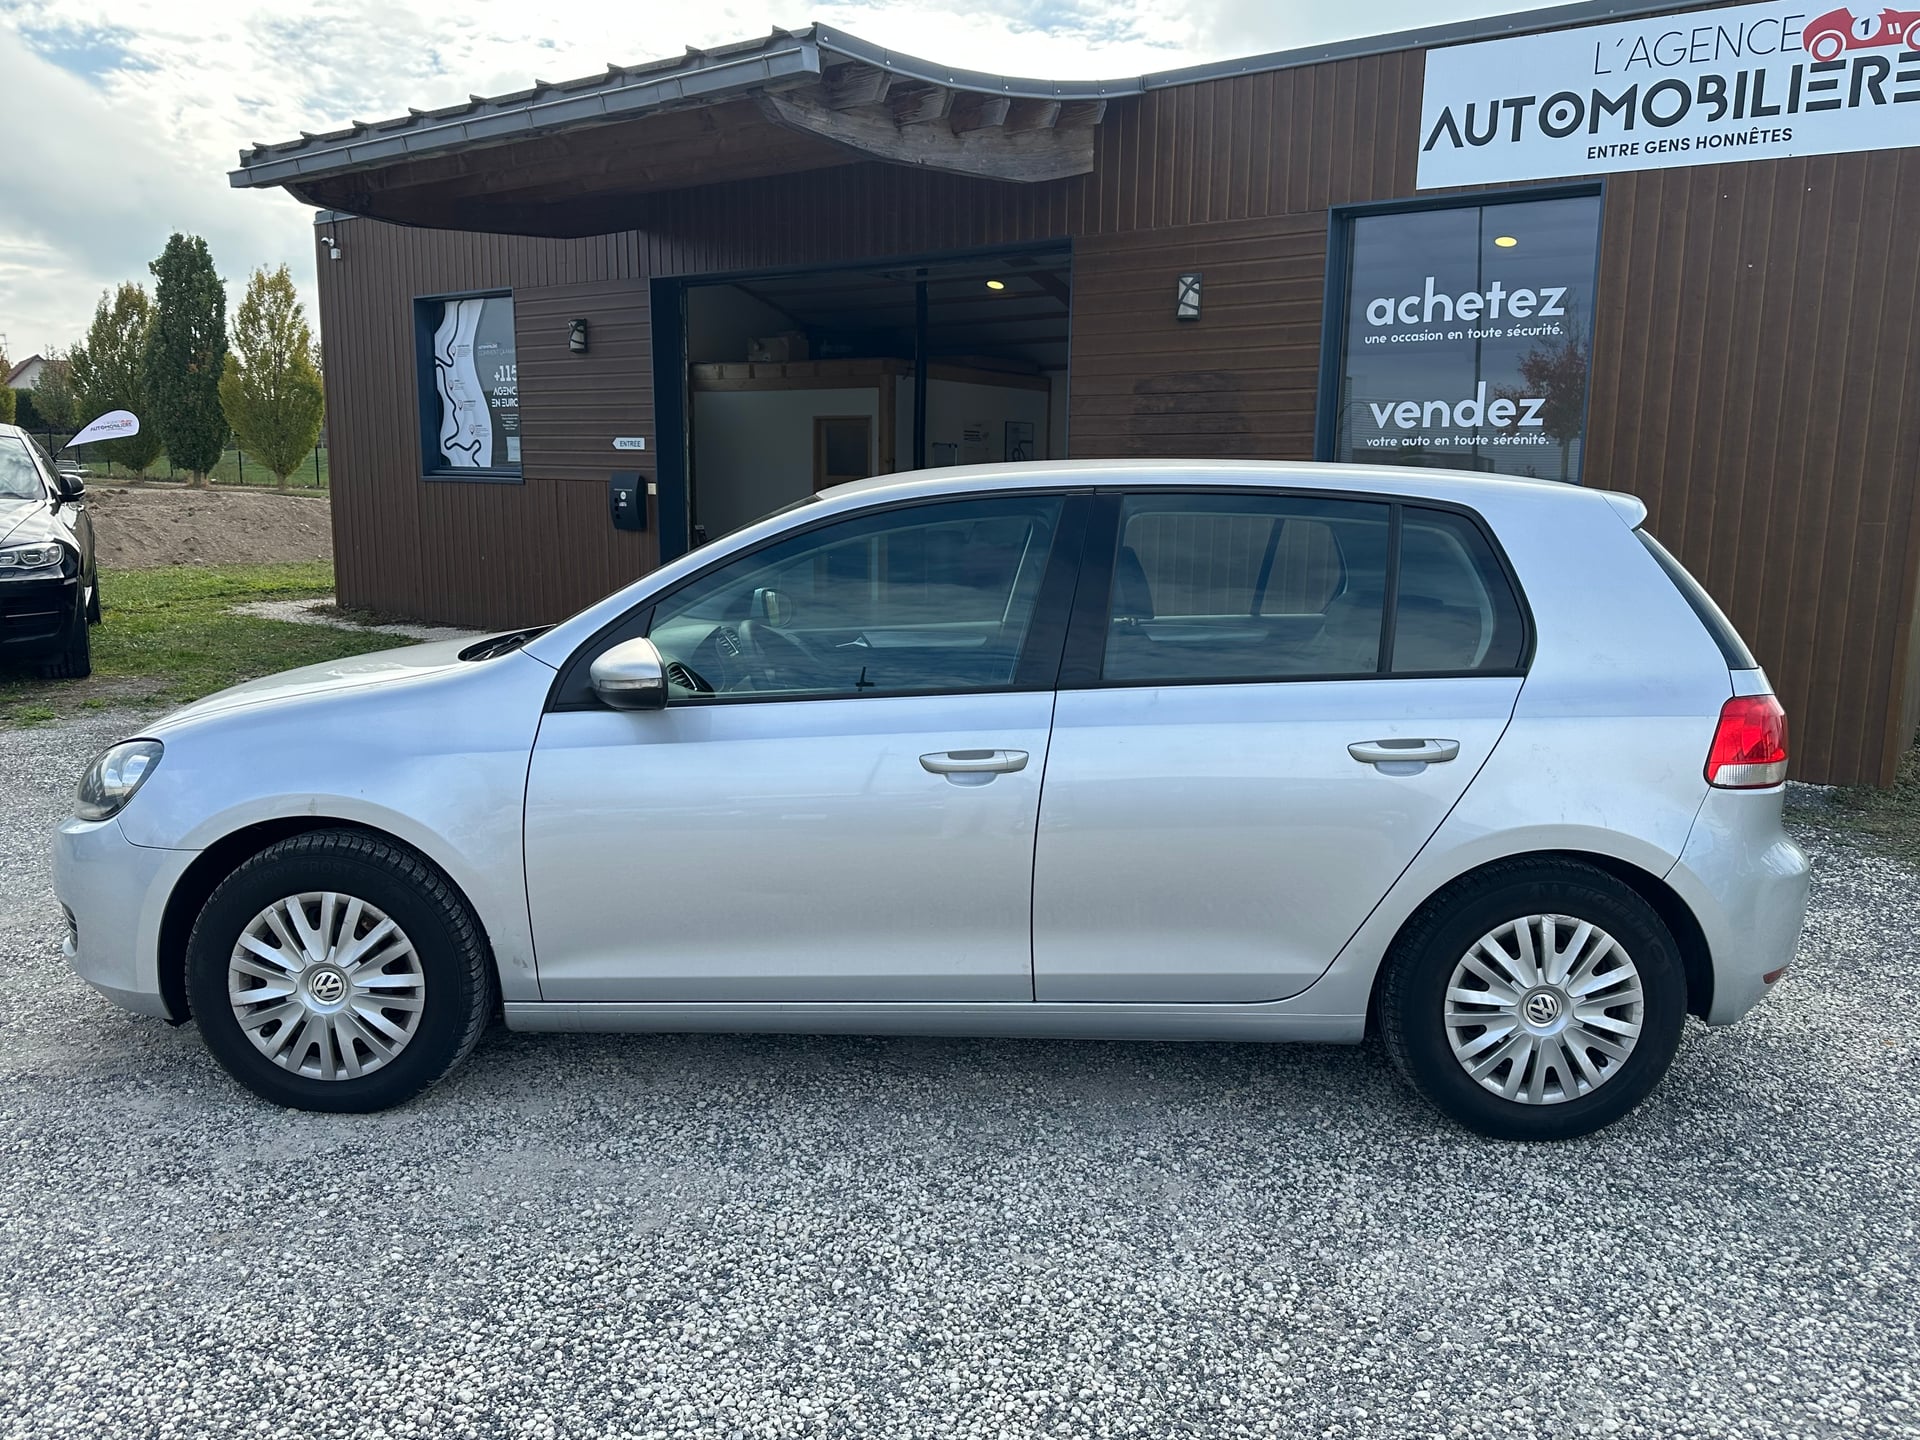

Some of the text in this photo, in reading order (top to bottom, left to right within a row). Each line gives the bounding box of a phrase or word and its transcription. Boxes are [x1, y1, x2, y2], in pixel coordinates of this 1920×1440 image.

[1586, 126, 1793, 160] ENTRE GENS HONNÊTES
[1366, 276, 1567, 326] achetez
[1364, 321, 1563, 344] une occasion en toute sécurité.
[1369, 381, 1546, 429] vendez
[1366, 431, 1549, 447] votre auto en toute sérénité.
